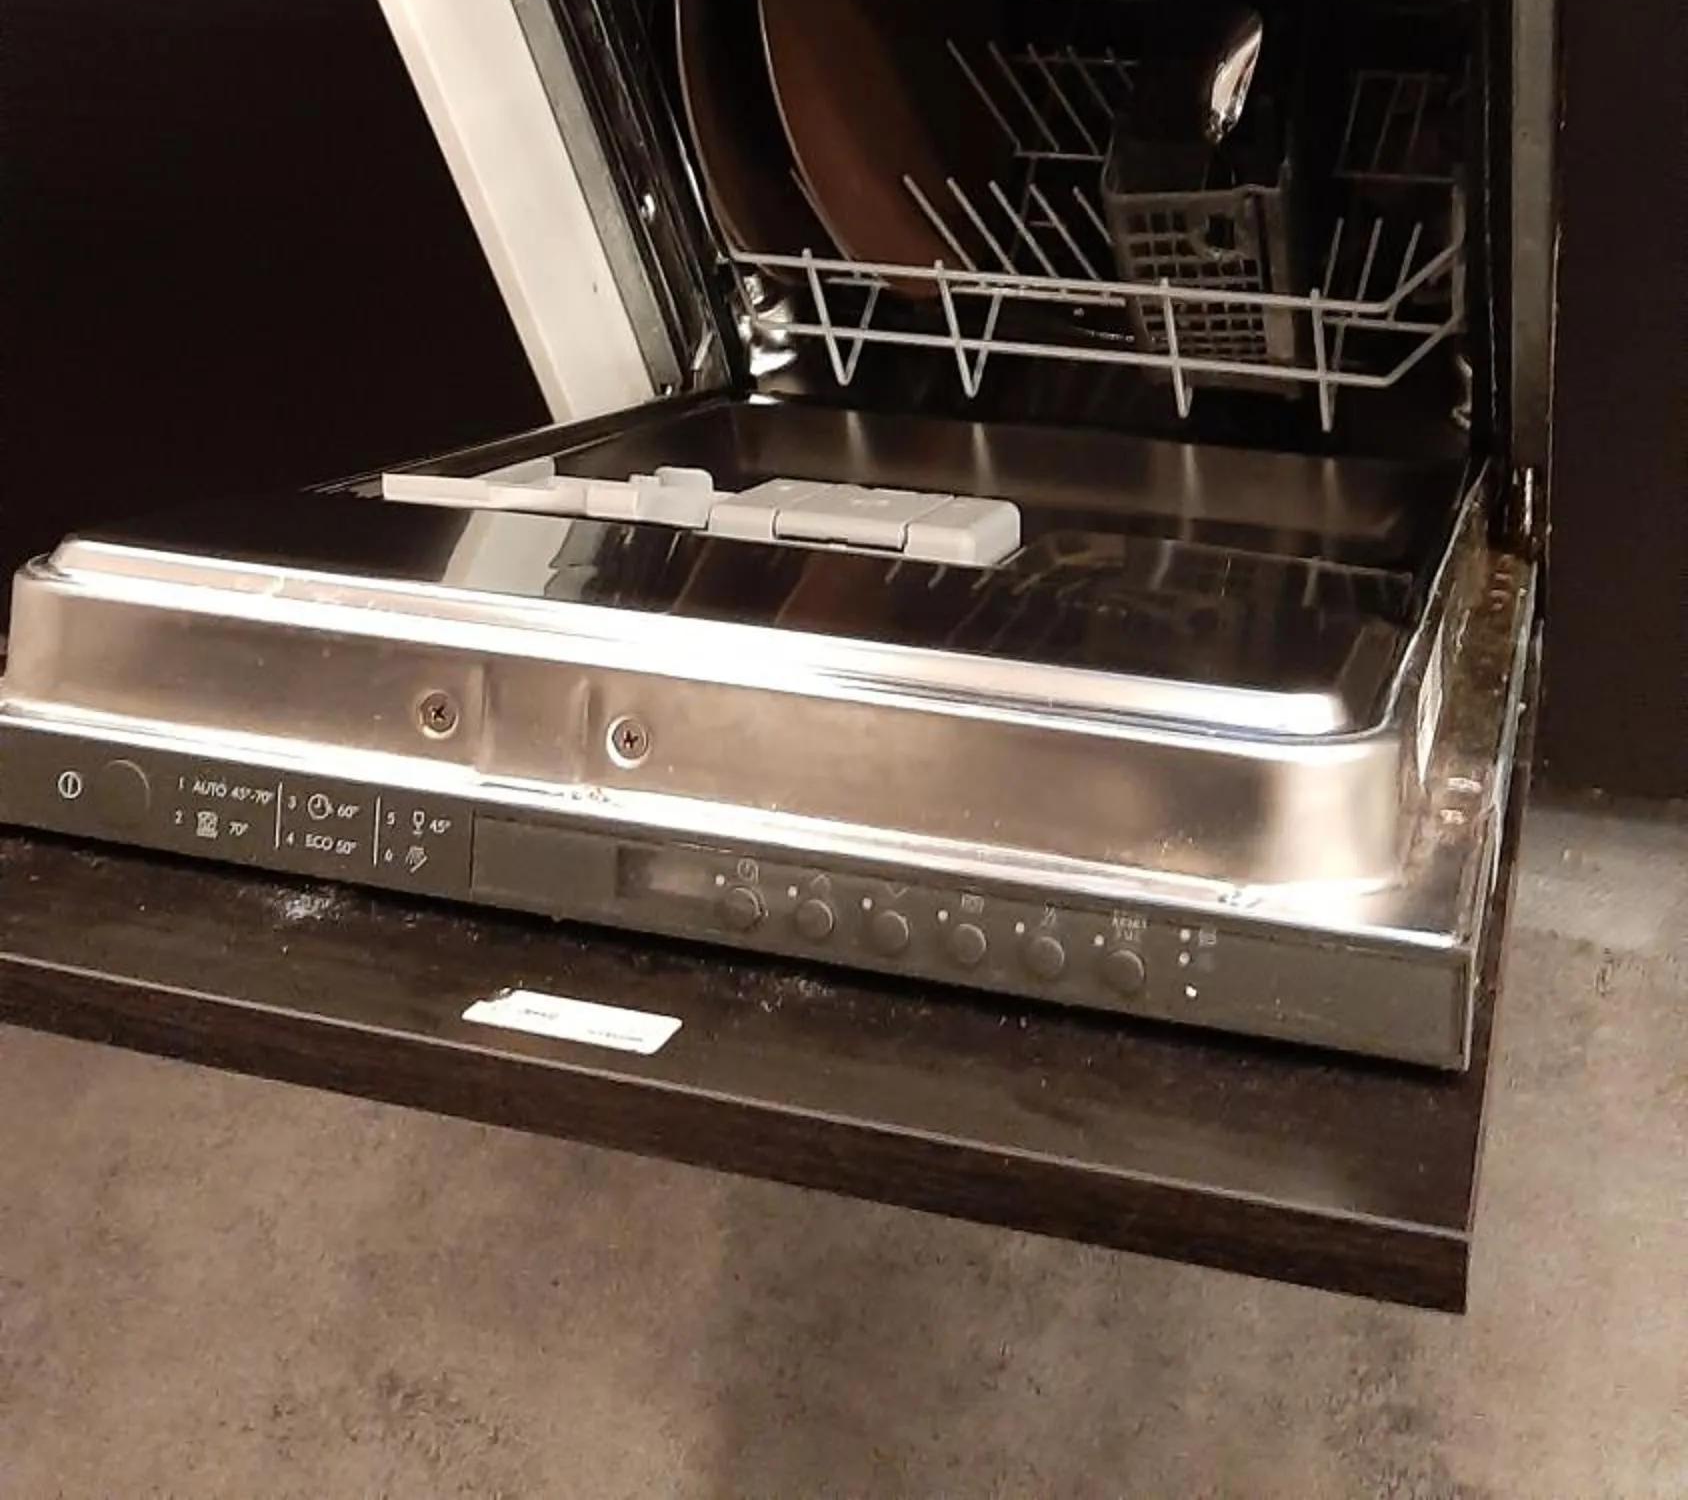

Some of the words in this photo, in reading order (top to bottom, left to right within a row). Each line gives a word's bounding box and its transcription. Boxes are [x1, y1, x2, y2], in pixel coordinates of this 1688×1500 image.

[193, 780, 228, 798] AUTO
[287, 795, 297, 810] 3
[175, 809, 184, 825] 2
[386, 811, 396, 826] 5
[286, 831, 295, 846] 4
[305, 833, 334, 851] ECO
[384, 847, 394, 862] 6
